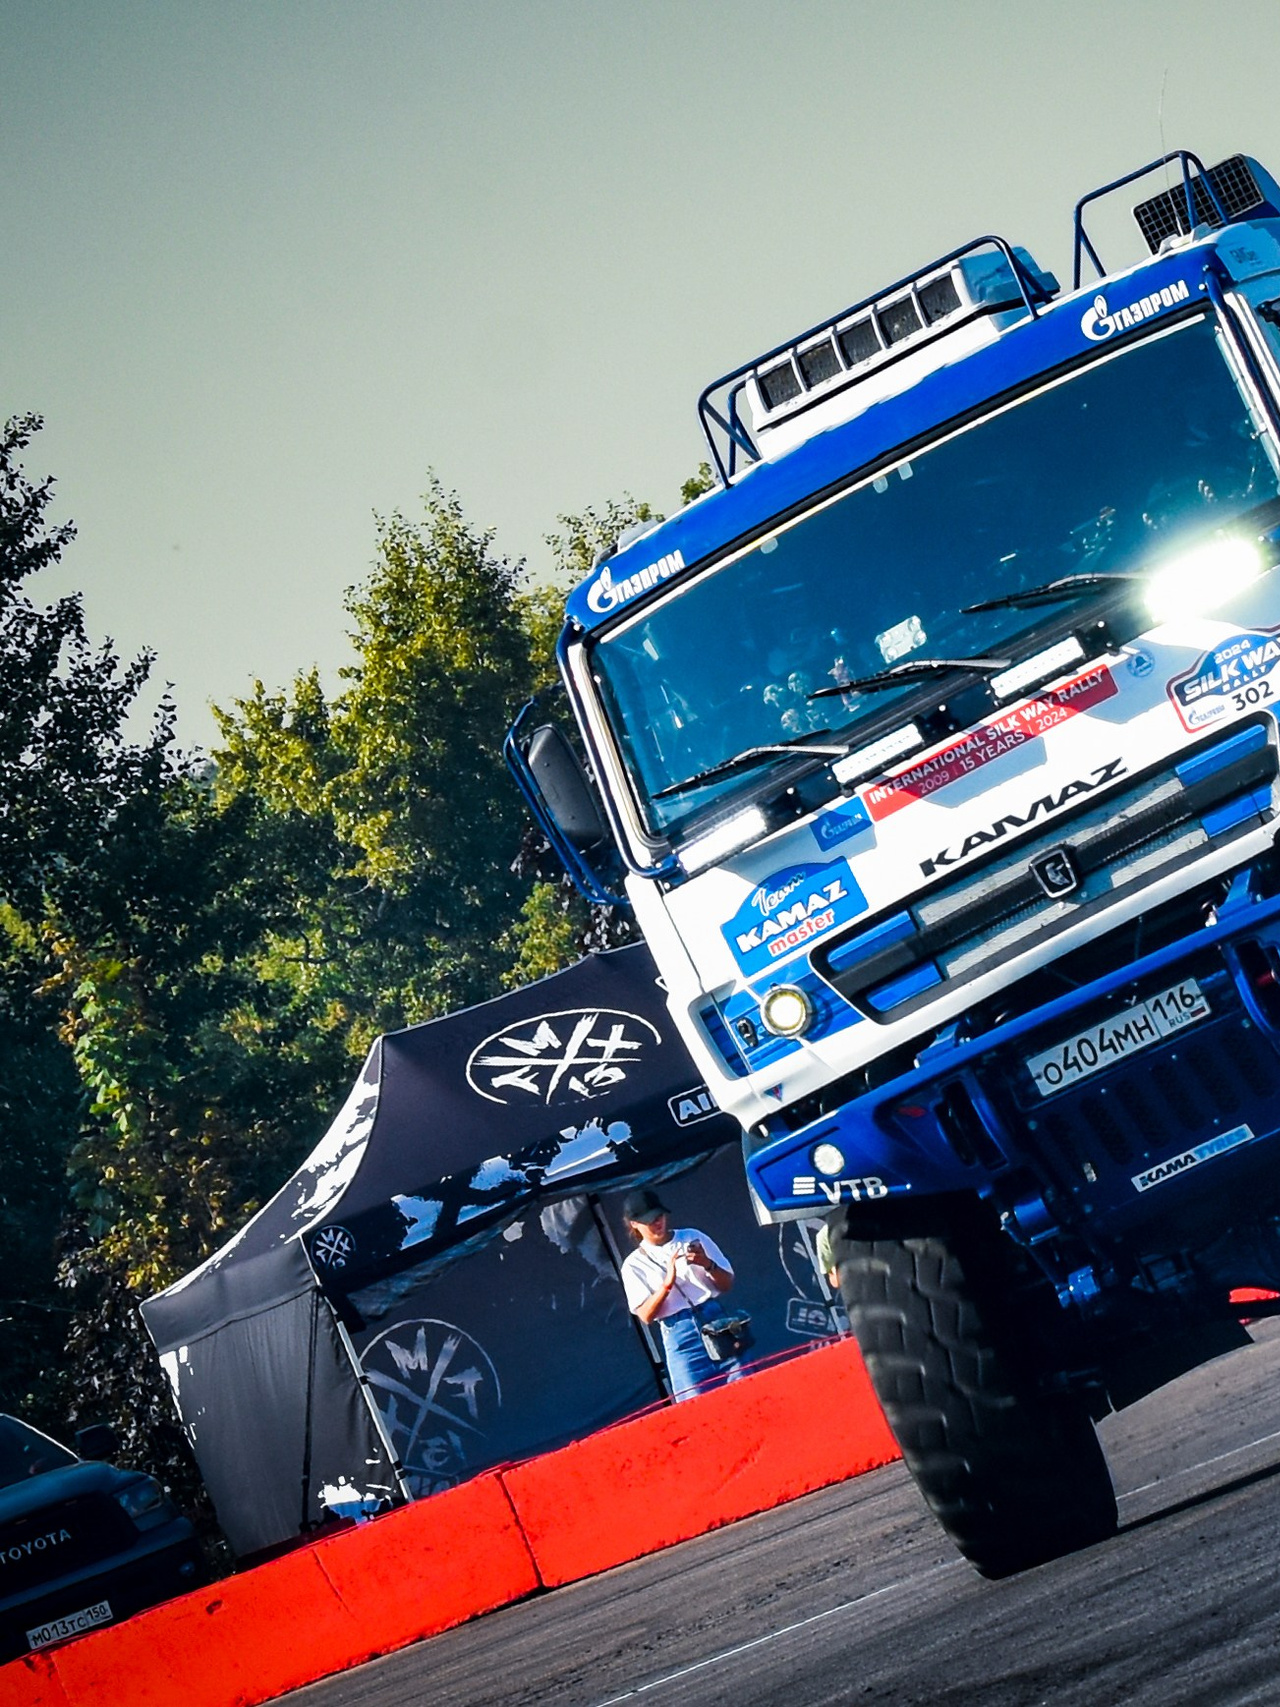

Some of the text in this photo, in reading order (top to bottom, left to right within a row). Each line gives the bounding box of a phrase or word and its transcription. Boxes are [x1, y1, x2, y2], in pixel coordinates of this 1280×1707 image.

[1114, 279, 1190, 331] ГАЗПРОМ
[616, 549, 685, 603] ГАЗПРОМ
[1214, 639, 1251, 664] 2024
[1184, 658, 1241, 702] SILK
[1232, 681, 1274, 712] 302
[869, 669, 1105, 805] INTERNATIONAL SILK WAY RALLY
[917, 707, 1068, 795] 2009 15 YEARS 2024
[919, 756, 1129, 878] KAMAZ
[736, 879, 848, 953] KAMAZ
[751, 872, 806, 917] Team
[768, 909, 835, 957] master
[1152, 985, 1195, 1020] 116
[1168, 1012, 1191, 1028] RUS
[818, 1176, 888, 1204] VTB
[0, 1529, 72, 1565] TOYOTA
